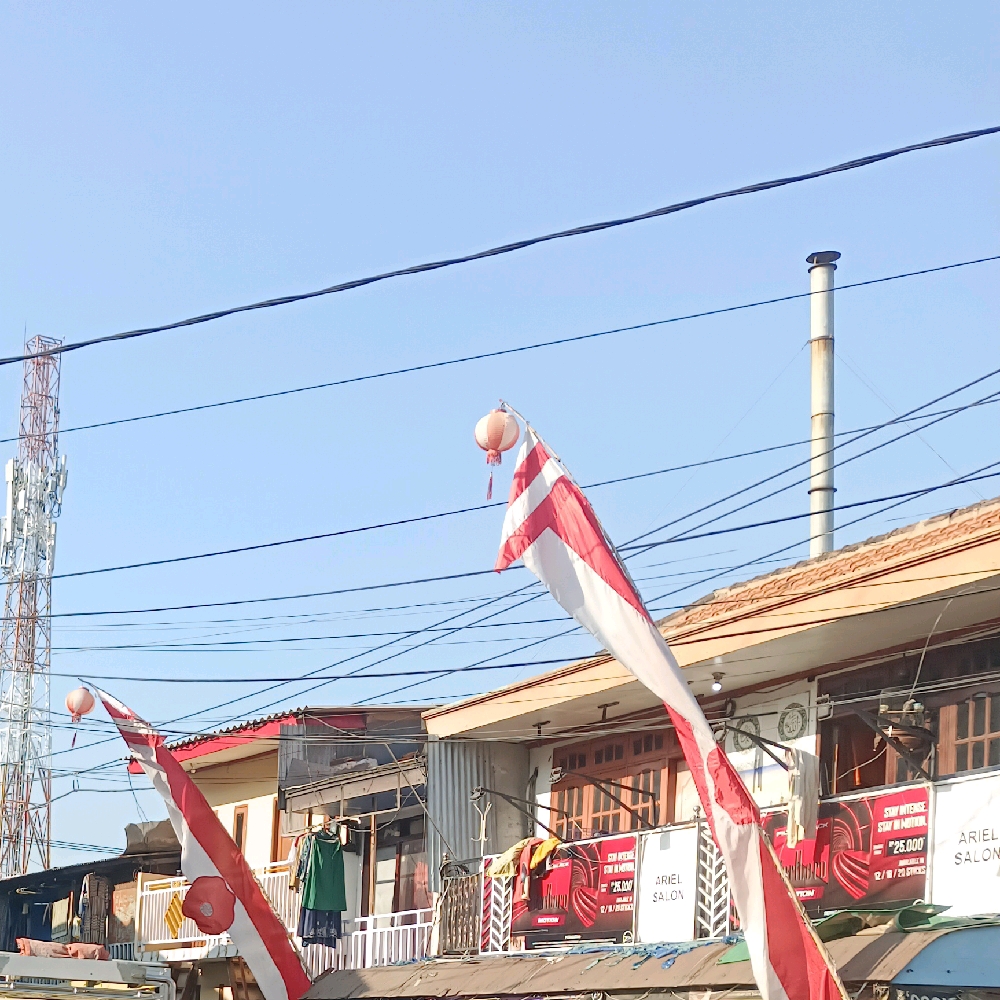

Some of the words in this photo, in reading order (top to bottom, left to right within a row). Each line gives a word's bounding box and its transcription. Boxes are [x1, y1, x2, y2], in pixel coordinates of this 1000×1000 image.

[883, 805, 899, 819] STAY
[877, 820, 893, 833] STAY
[894, 819, 902, 831] IN
[958, 828, 999, 845] ARIEL
[954, 847, 1000, 865] SALON
[655, 873, 683, 886] ARIEL
[874, 871, 881, 881] 12
[897, 868, 905, 878] 20
[653, 889, 685, 903] SALON
